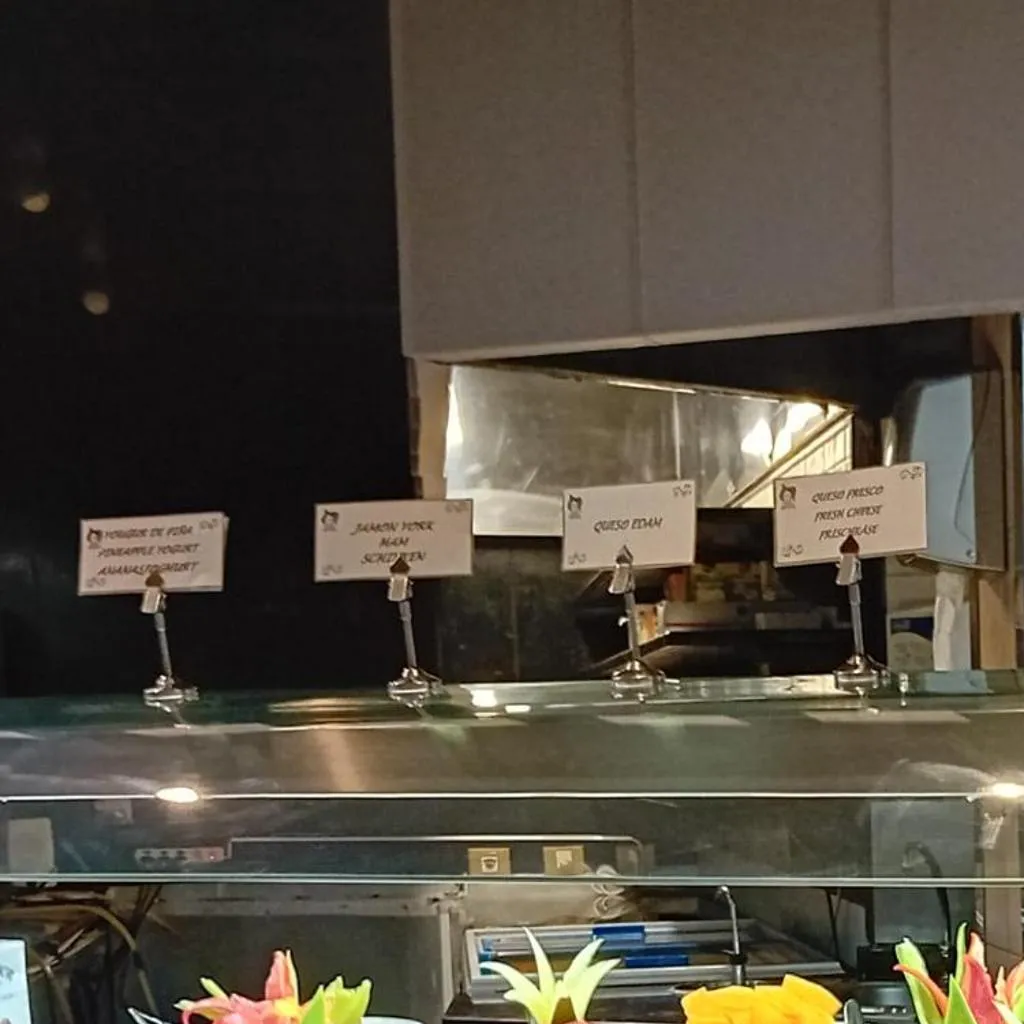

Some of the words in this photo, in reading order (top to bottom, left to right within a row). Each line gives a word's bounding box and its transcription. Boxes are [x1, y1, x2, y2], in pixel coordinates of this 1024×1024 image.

[811, 490, 845, 504] QUESO
[846, 485, 884, 499] FRESCO
[814, 507, 845, 522] FRESH
[846, 505, 883, 518] CHEESE
[400, 520, 435, 531] YORK
[594, 518, 630, 534] QUESO
[631, 516, 663, 530] EDAM
[379, 536, 410, 547] HAM
[97, 545, 155, 557] PINEAPPLE
